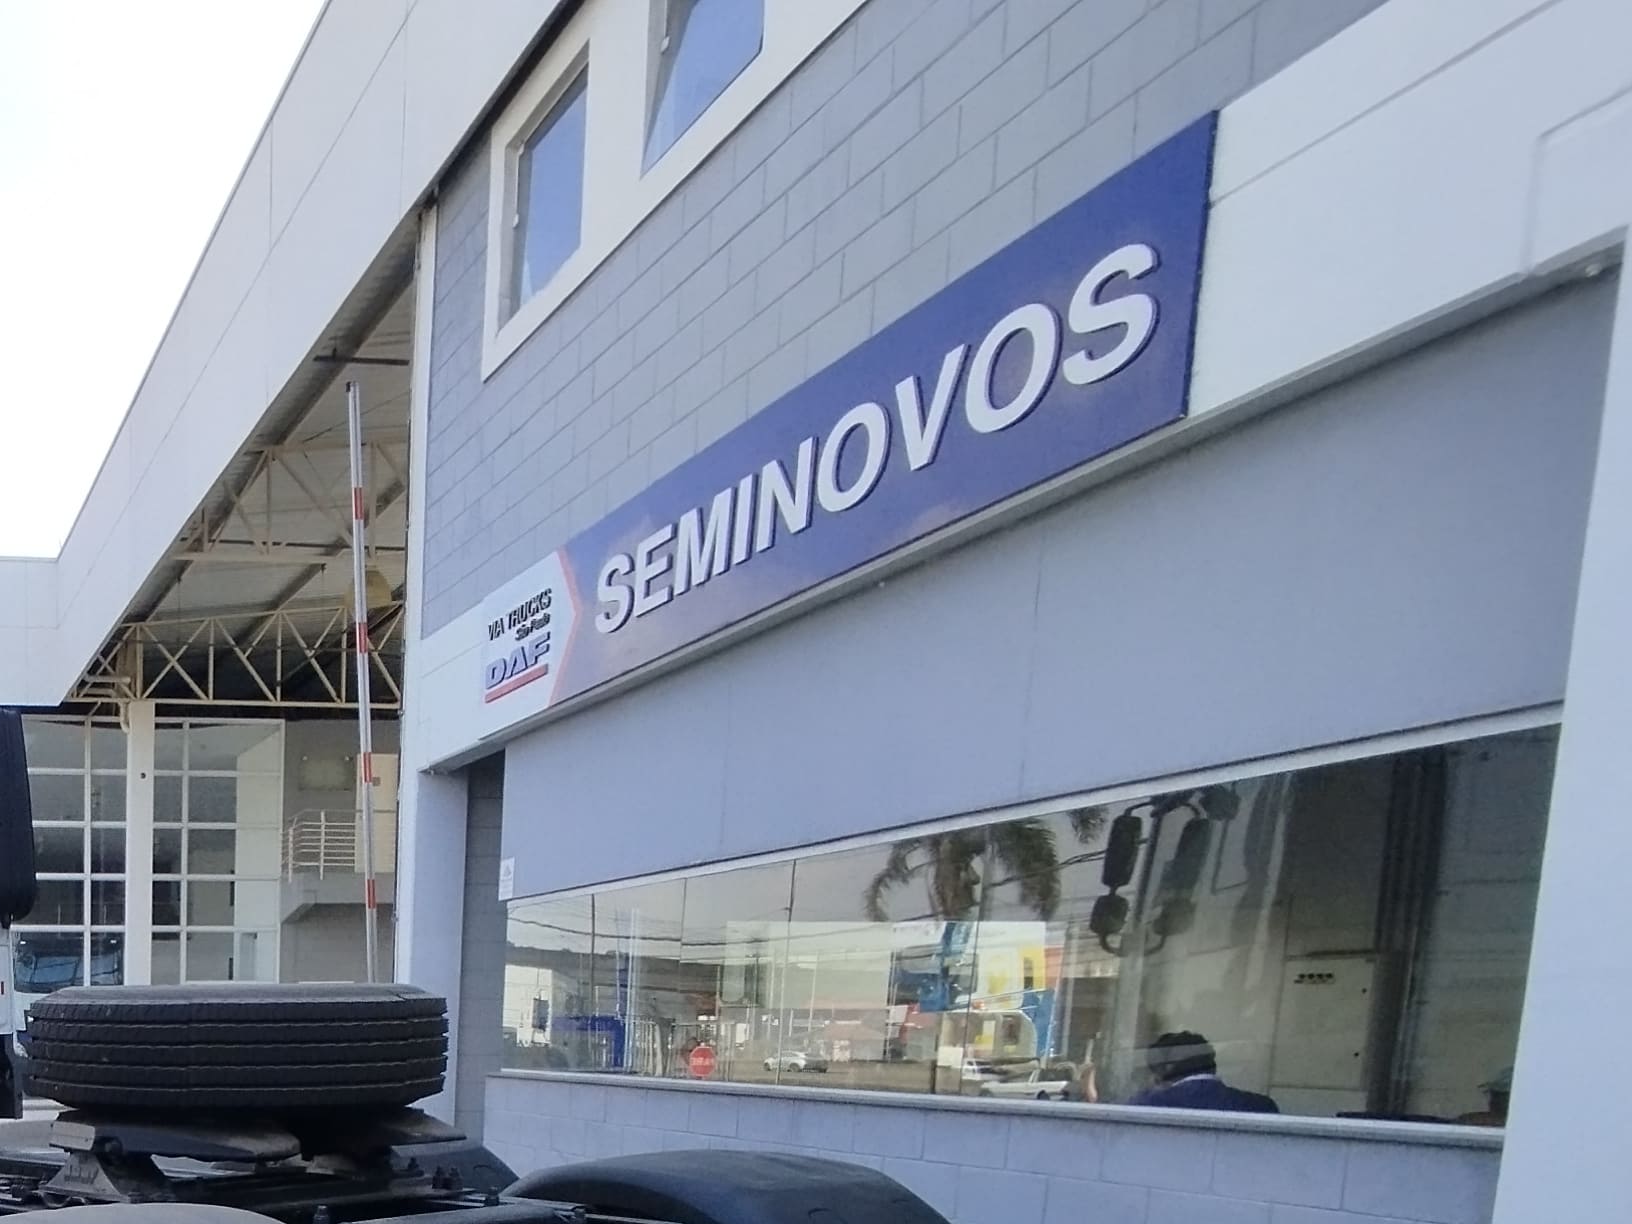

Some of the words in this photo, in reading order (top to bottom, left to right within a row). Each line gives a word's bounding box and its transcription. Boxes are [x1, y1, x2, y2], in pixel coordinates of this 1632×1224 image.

[594, 243, 1161, 634] SEMINOVOS
[488, 617, 505, 641] VIA
[507, 587, 553, 630] TRUCKS
[485, 631, 551, 690] DAF
